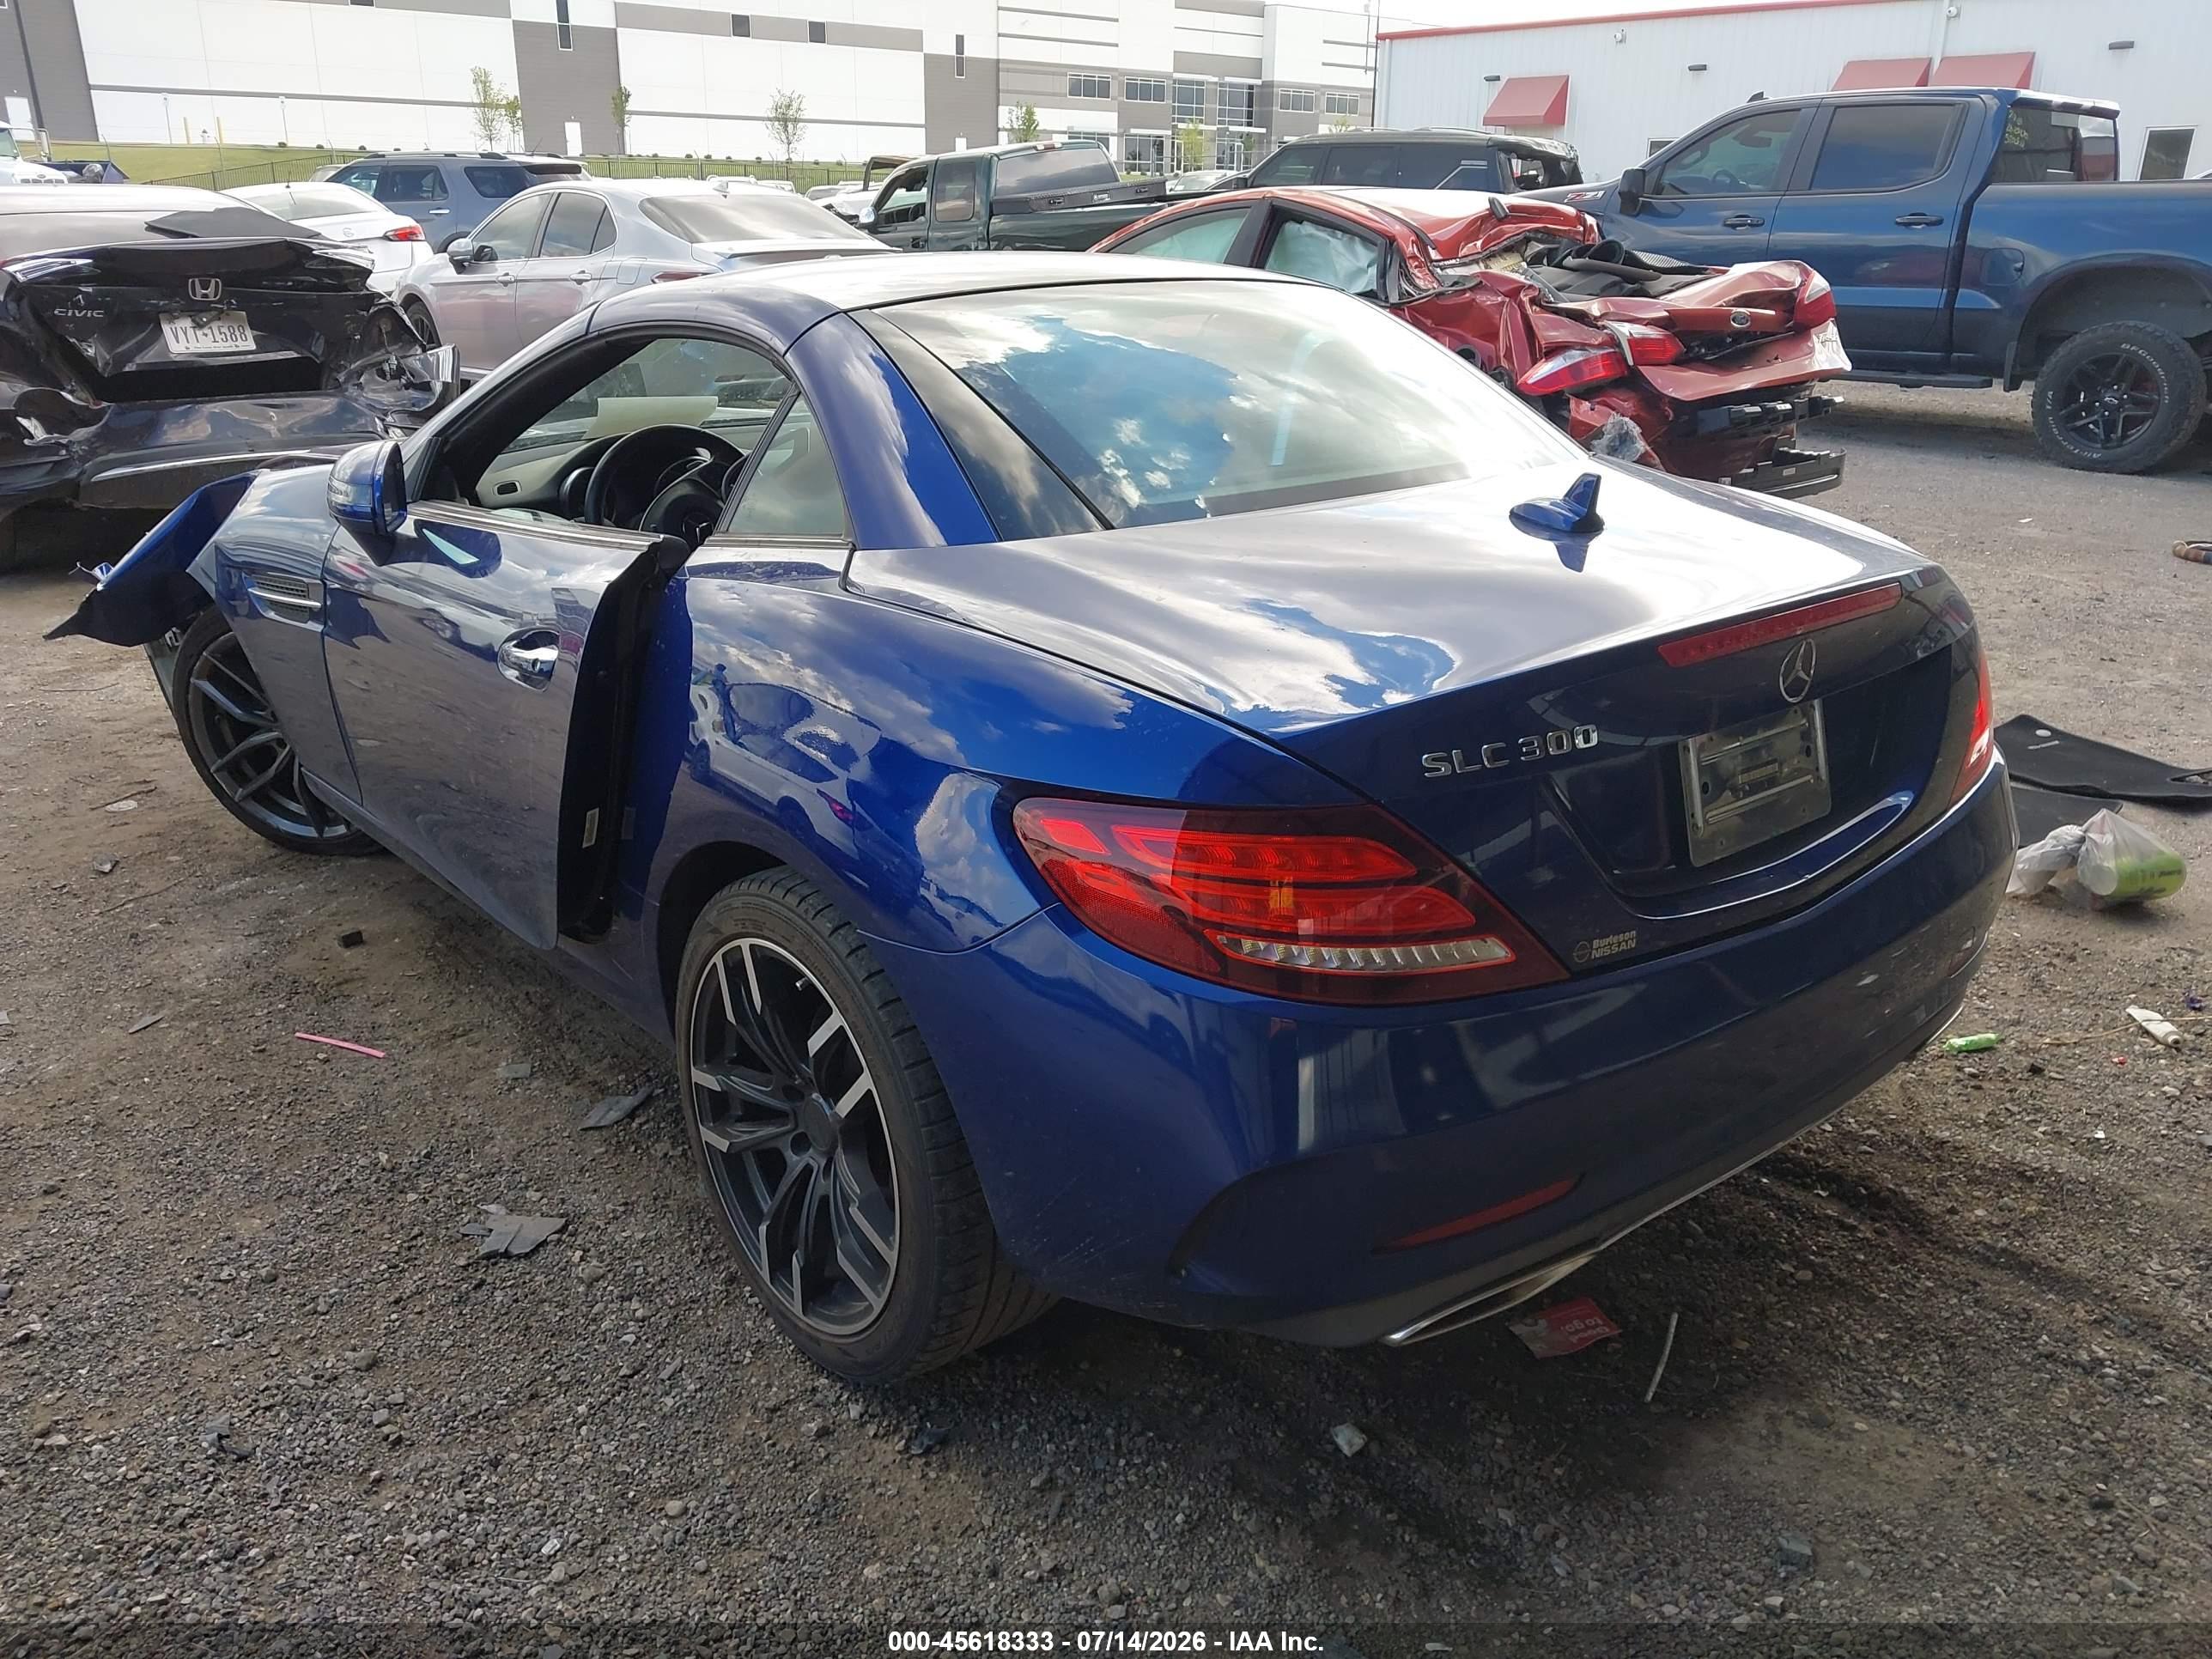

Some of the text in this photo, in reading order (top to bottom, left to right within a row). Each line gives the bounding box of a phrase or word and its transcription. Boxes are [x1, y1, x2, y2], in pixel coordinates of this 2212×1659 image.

[53, 308, 105, 318] CIVIC
[207, 324, 248, 343] 1588
[1421, 724, 1598, 778] SLC 300
[1591, 939, 1636, 959] NISSAN
